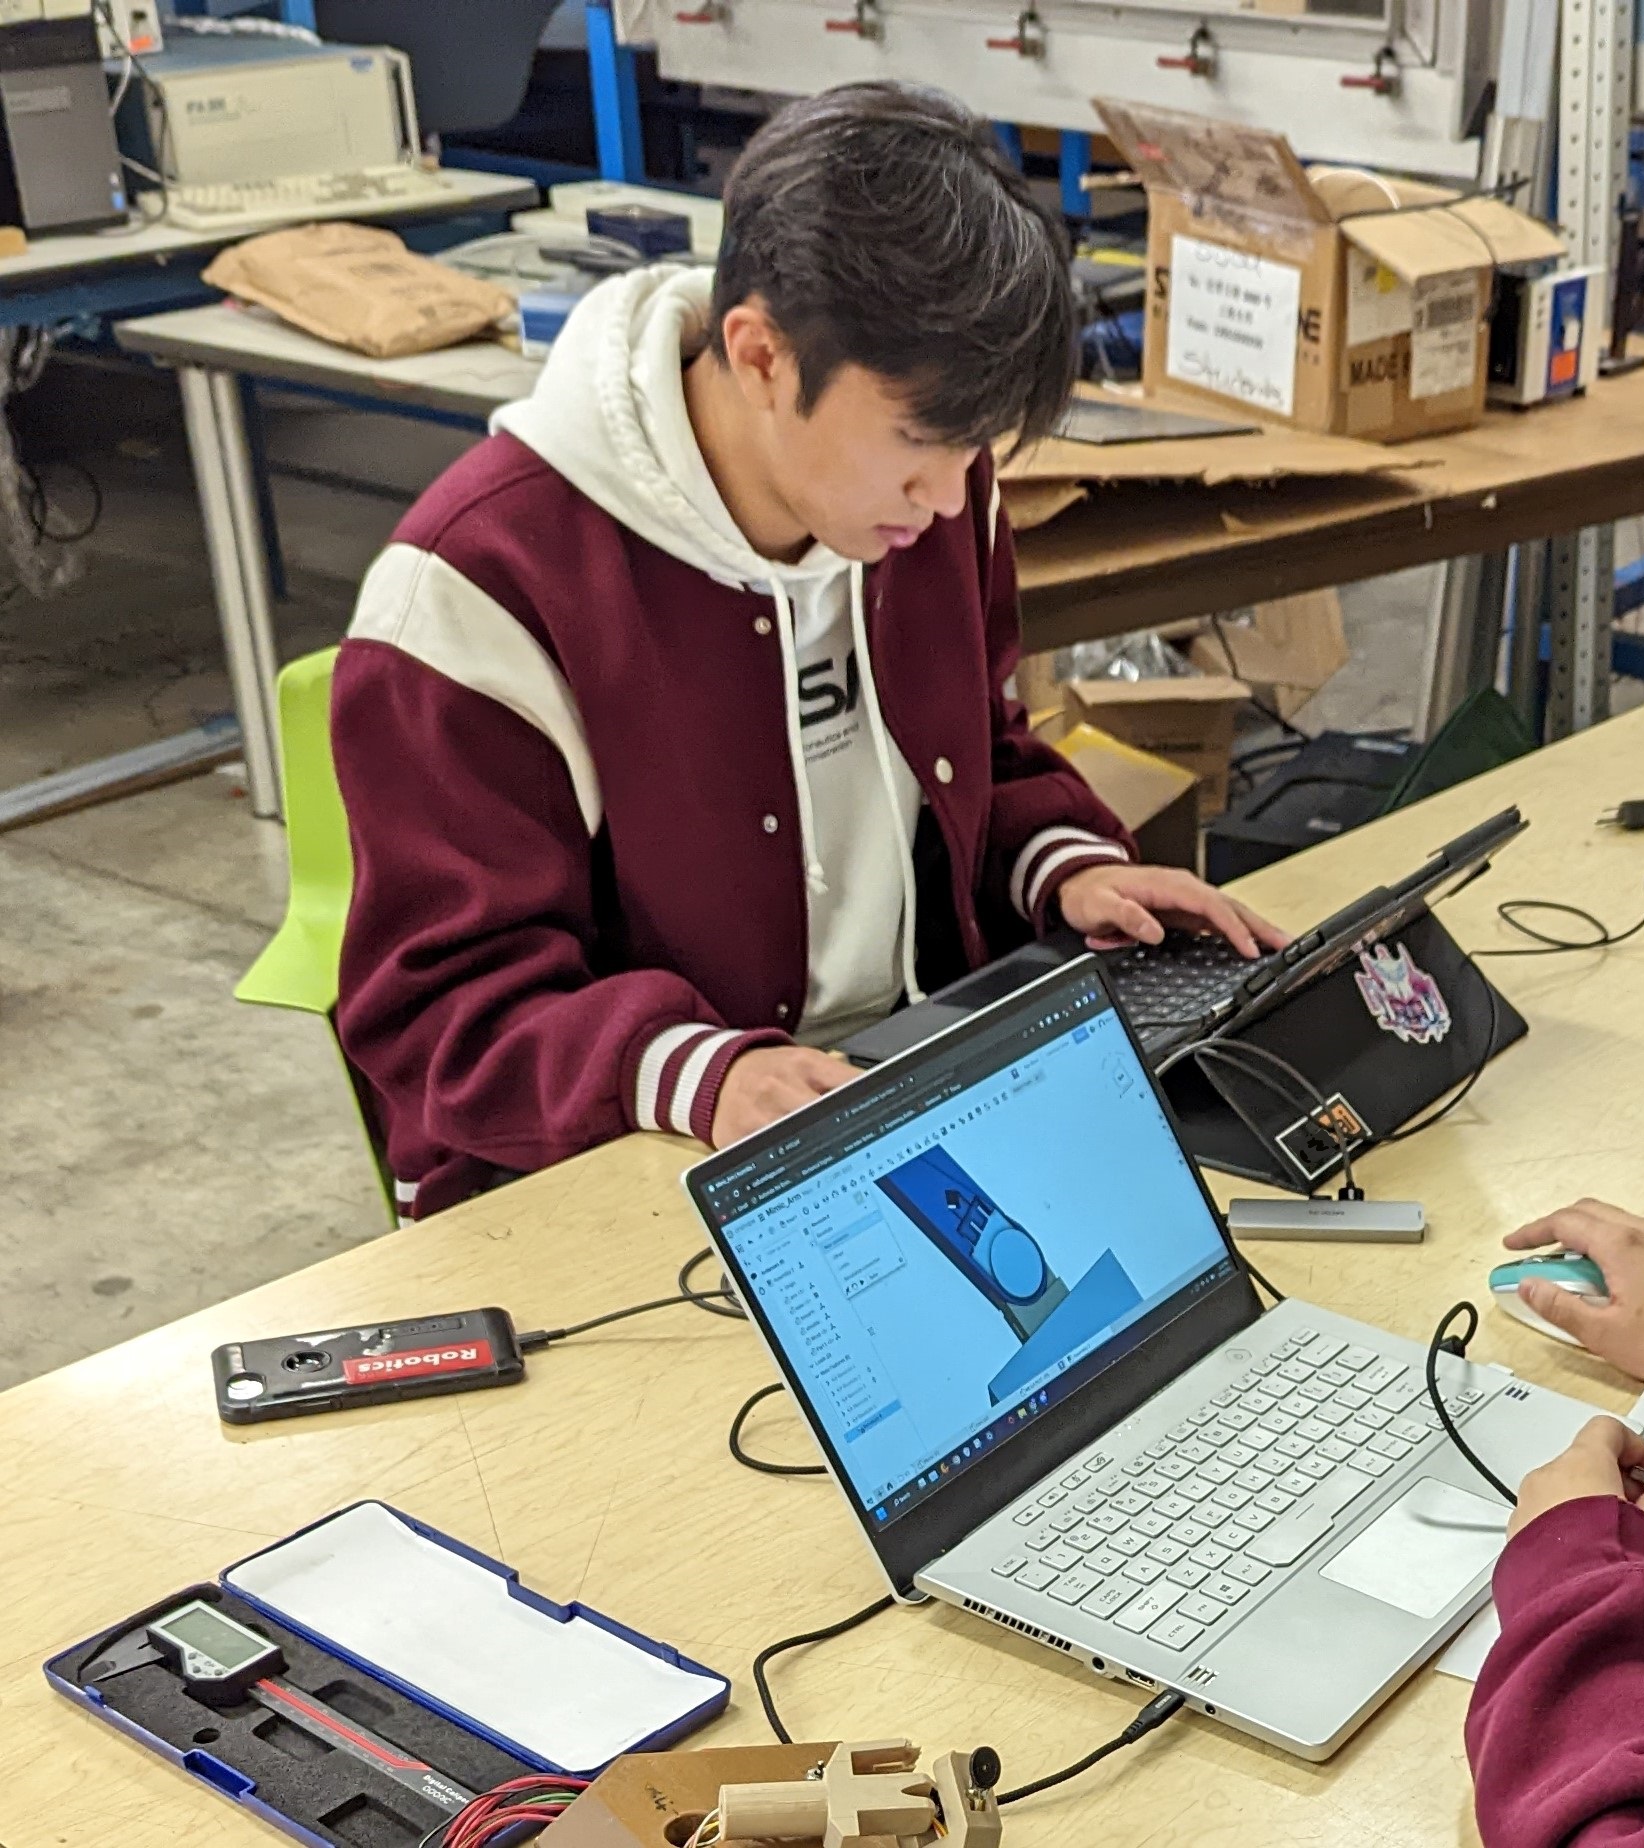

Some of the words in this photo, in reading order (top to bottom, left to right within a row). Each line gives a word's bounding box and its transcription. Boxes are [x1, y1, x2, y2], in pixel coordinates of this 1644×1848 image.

[764, 1190, 803, 1219] Mimic_Arm
[358, 1348, 477, 1373] Robotics
[1097, 1587, 1117, 1602] CAPS
[1104, 1590, 1123, 1605] LOCK
[1166, 1622, 1186, 1638] CTRL
[423, 1774, 447, 1791] Digital
